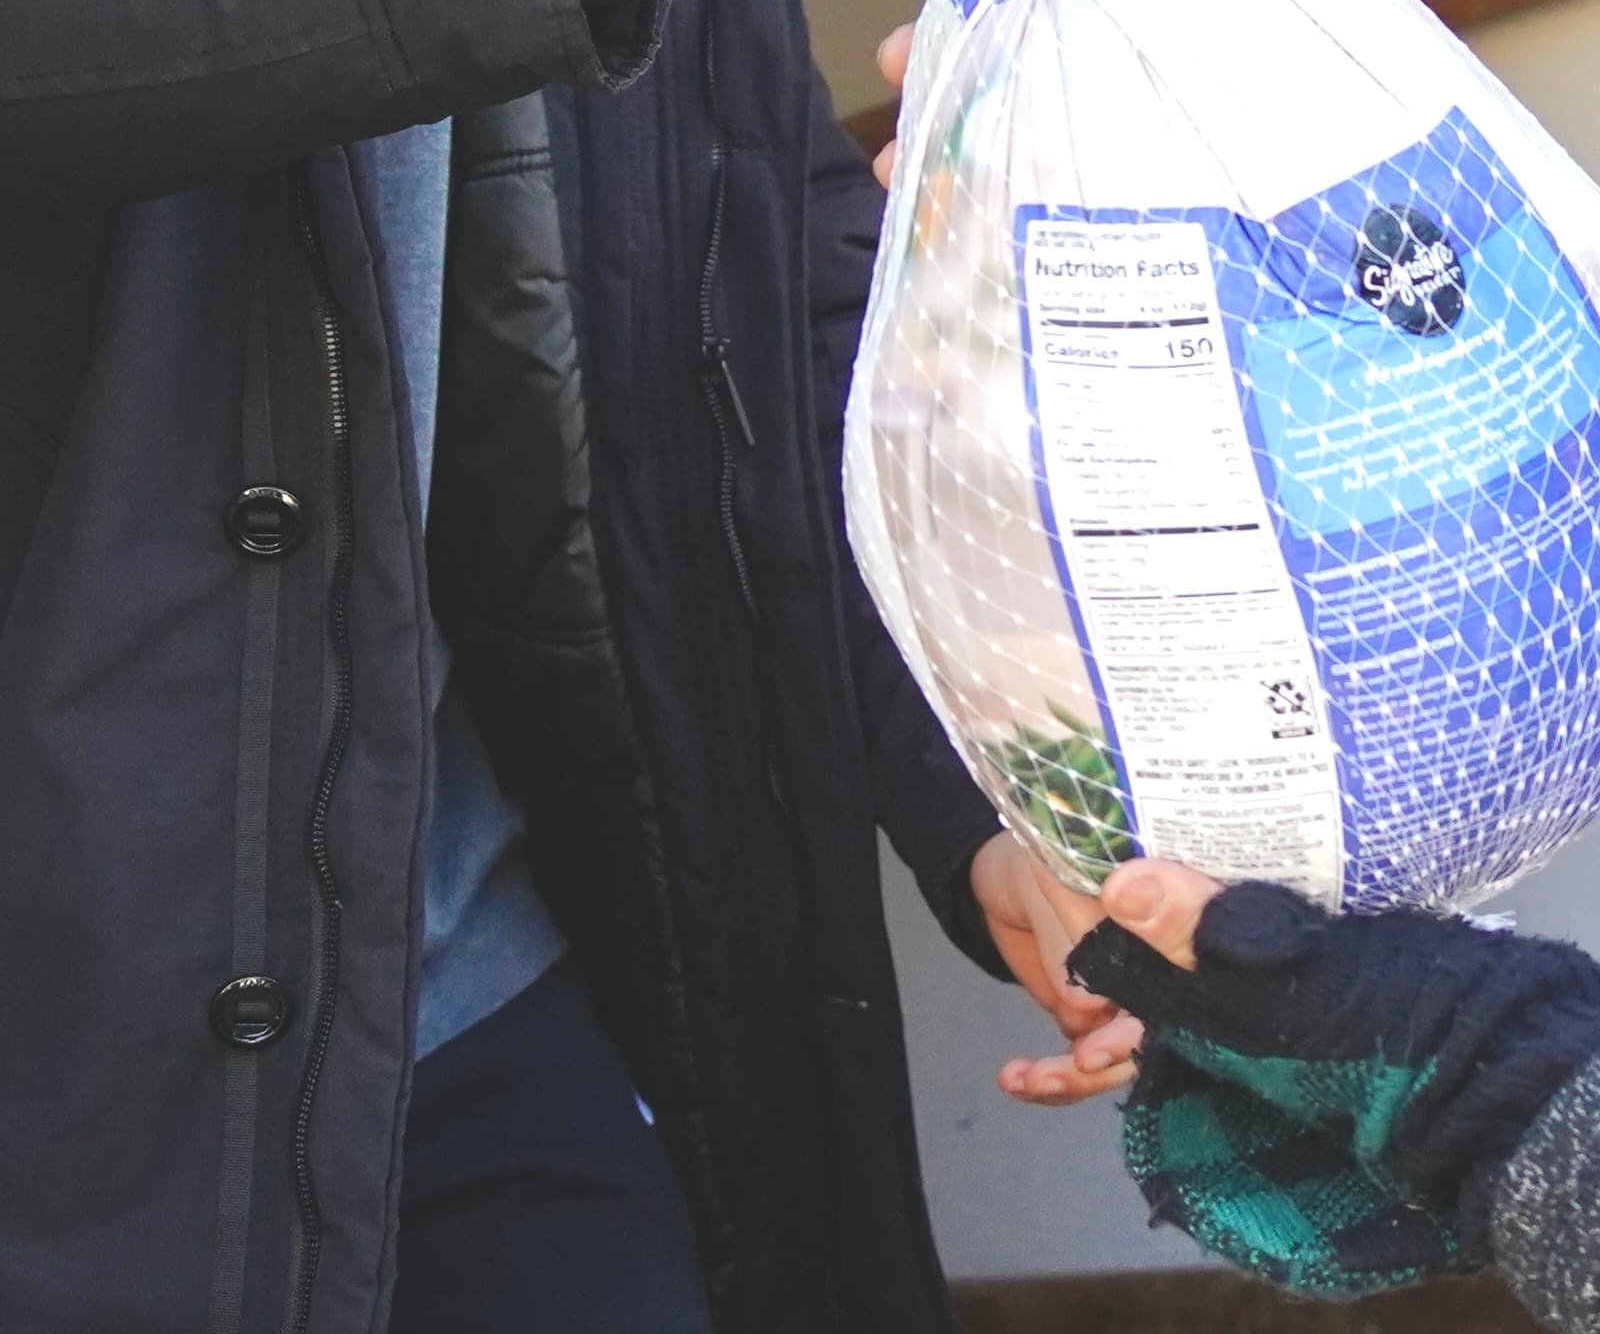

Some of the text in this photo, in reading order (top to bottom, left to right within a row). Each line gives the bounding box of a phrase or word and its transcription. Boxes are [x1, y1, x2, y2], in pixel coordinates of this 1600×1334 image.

[1036, 257, 1199, 278] Nutrition Facts
[1045, 343, 1118, 359] Calories
